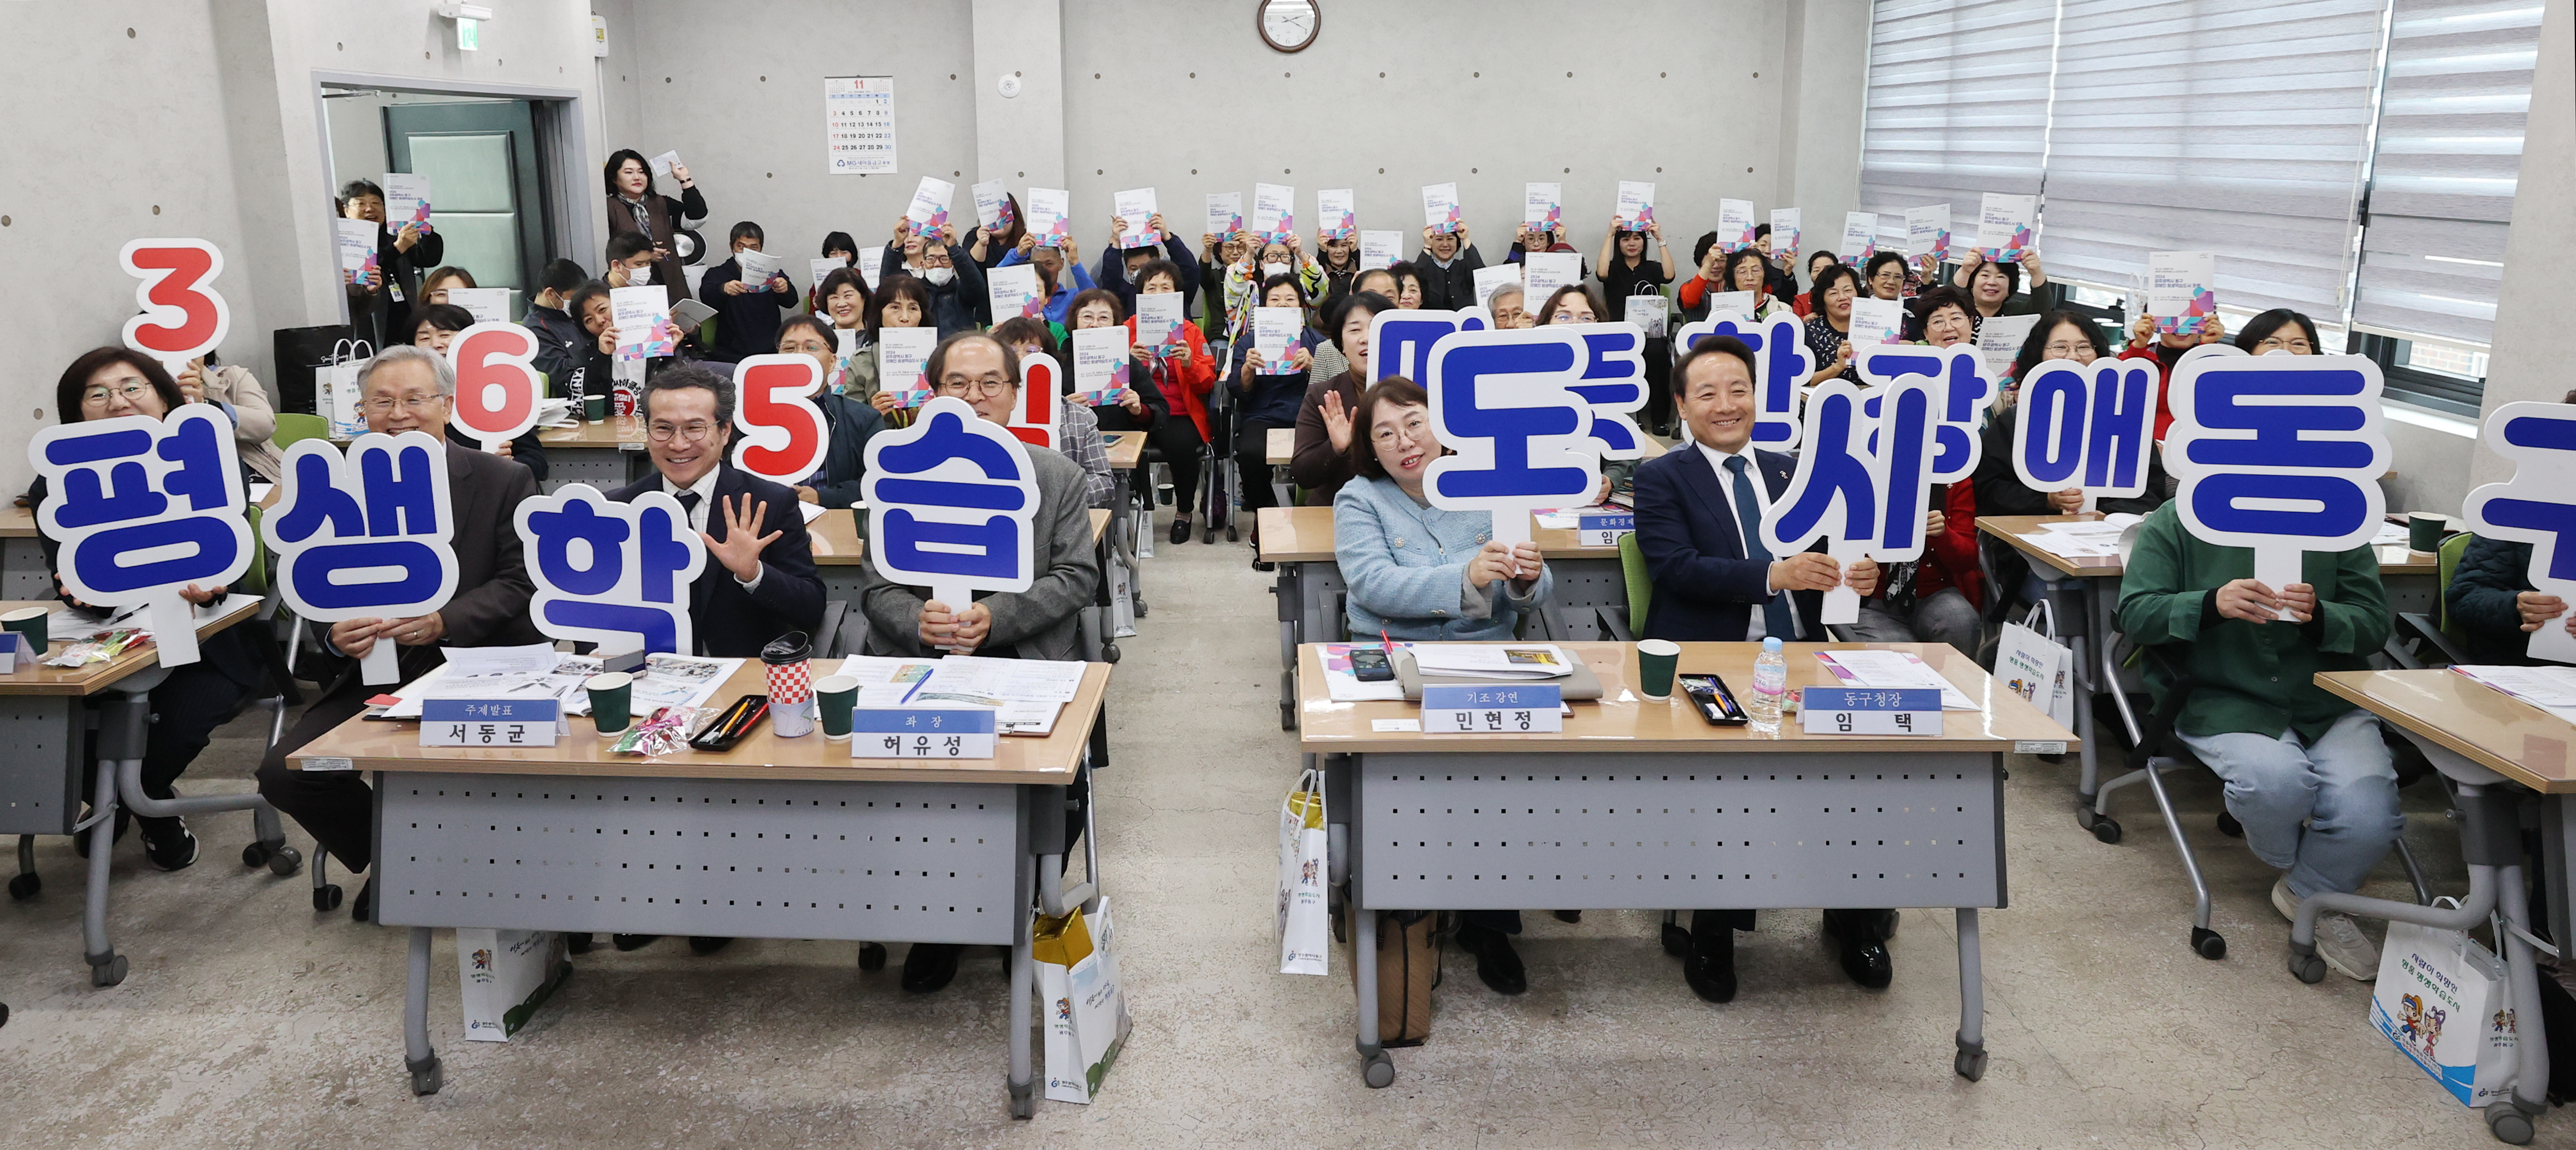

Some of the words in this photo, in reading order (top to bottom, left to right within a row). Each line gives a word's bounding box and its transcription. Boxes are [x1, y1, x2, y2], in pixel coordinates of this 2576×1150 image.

[855, 80, 863, 88] 11
[132, 247, 218, 352] 3
[456, 330, 532, 432] 6
[743, 369, 818, 475] 5
[1437, 342, 1587, 497] 도
[2025, 369, 2147, 488] 애
[45, 417, 237, 592] 평
[875, 412, 1025, 578] 습
[1775, 388, 1926, 549] 시
[2187, 370, 2374, 537] 동
[276, 446, 442, 609] 생
[528, 499, 690, 653] 학
[1602, 531, 1613, 544] 임
[465, 704, 513, 716] 주제발표
[1467, 692, 1490, 704] 기조
[1496, 692, 1519, 704] 강연
[1844, 692, 1903, 707] 동구청장
[2402, 959, 2414, 975] 명품
[2417, 973, 2460, 1013] 평생학습도시
[2412, 953, 2434, 975] 사람이
[2435, 973, 2457, 994] 희망인
